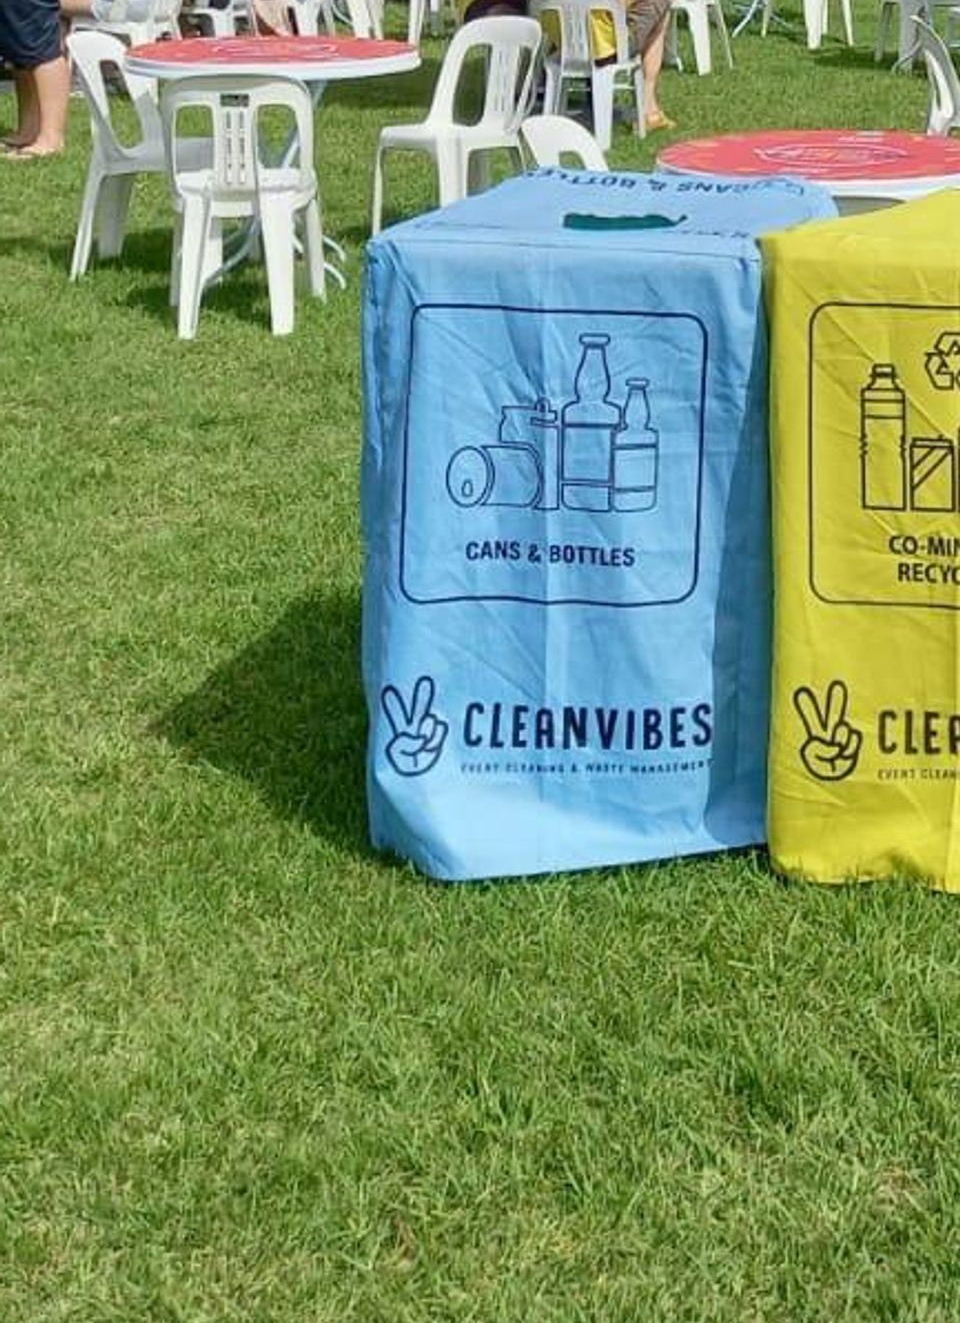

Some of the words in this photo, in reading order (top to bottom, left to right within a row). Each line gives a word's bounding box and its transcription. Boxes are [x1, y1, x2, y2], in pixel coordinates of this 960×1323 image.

[465, 541, 520, 562] CANS
[527, 544, 542, 563] &
[549, 544, 636, 567] BOTTLES
[463, 702, 712, 751] CLEANVIBES
[585, 762, 625, 775] WASTE
